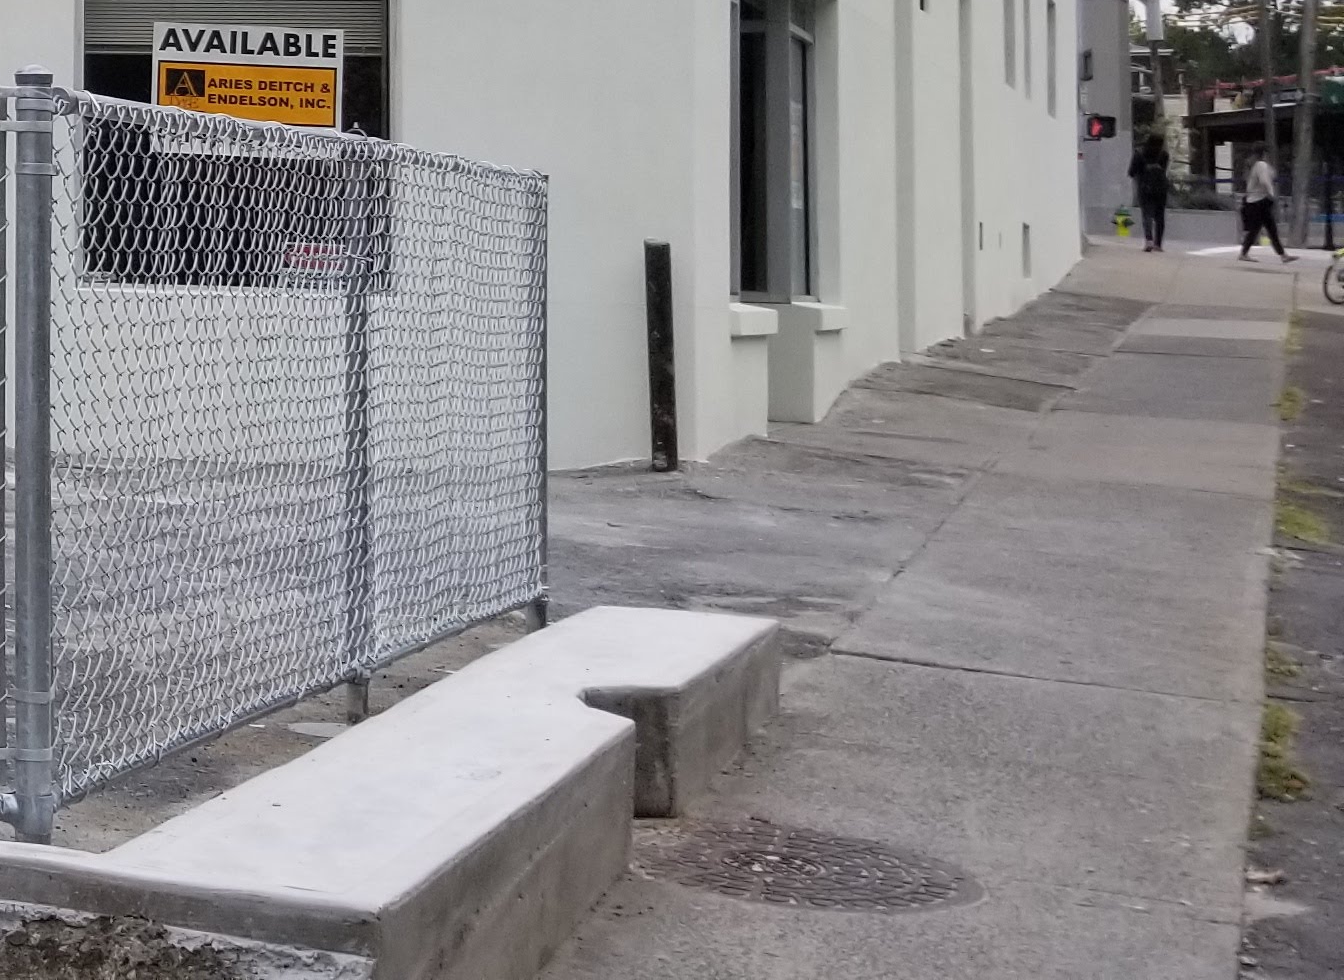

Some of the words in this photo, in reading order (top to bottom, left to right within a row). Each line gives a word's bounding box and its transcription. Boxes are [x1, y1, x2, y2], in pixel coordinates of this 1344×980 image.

[158, 28, 337, 58] AVAILABLE
[207, 78, 253, 90] ARIES
[258, 80, 315, 93] DEITCH
[320, 83, 331, 94] &
[207, 93, 294, 110] ENDELSON,
[299, 97, 331, 109] INC.
